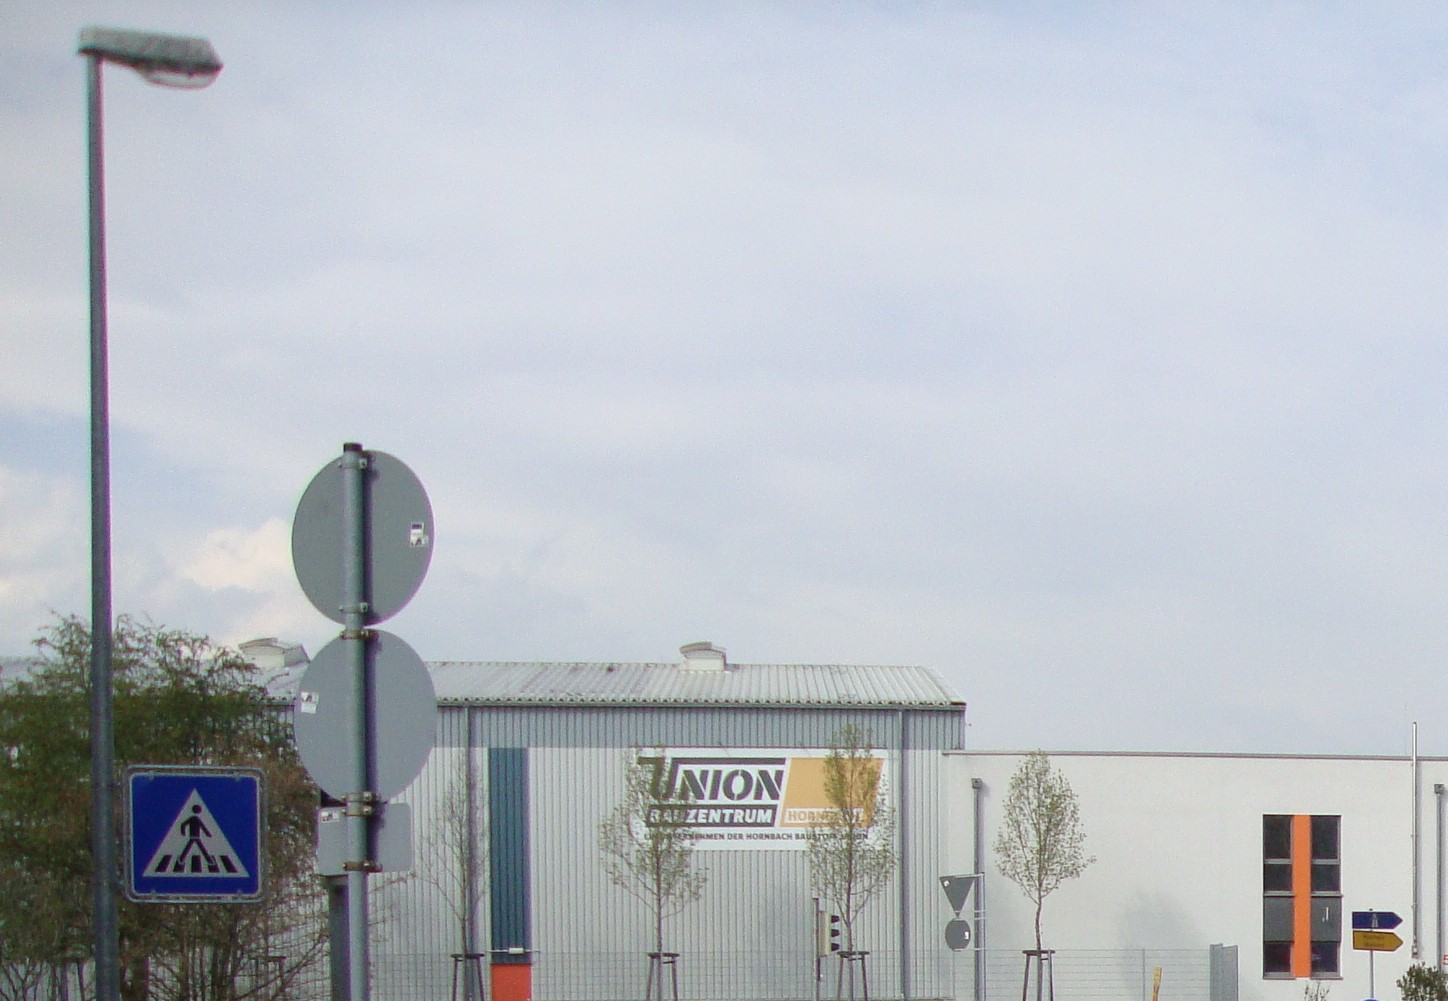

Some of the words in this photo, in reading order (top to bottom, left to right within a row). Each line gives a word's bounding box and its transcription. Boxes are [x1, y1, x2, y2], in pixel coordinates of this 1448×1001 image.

[637, 757, 786, 801] UNION
[788, 810, 861, 821] HORN
[727, 833, 744, 841] DER
[746, 833, 792, 841] HORNBACH
